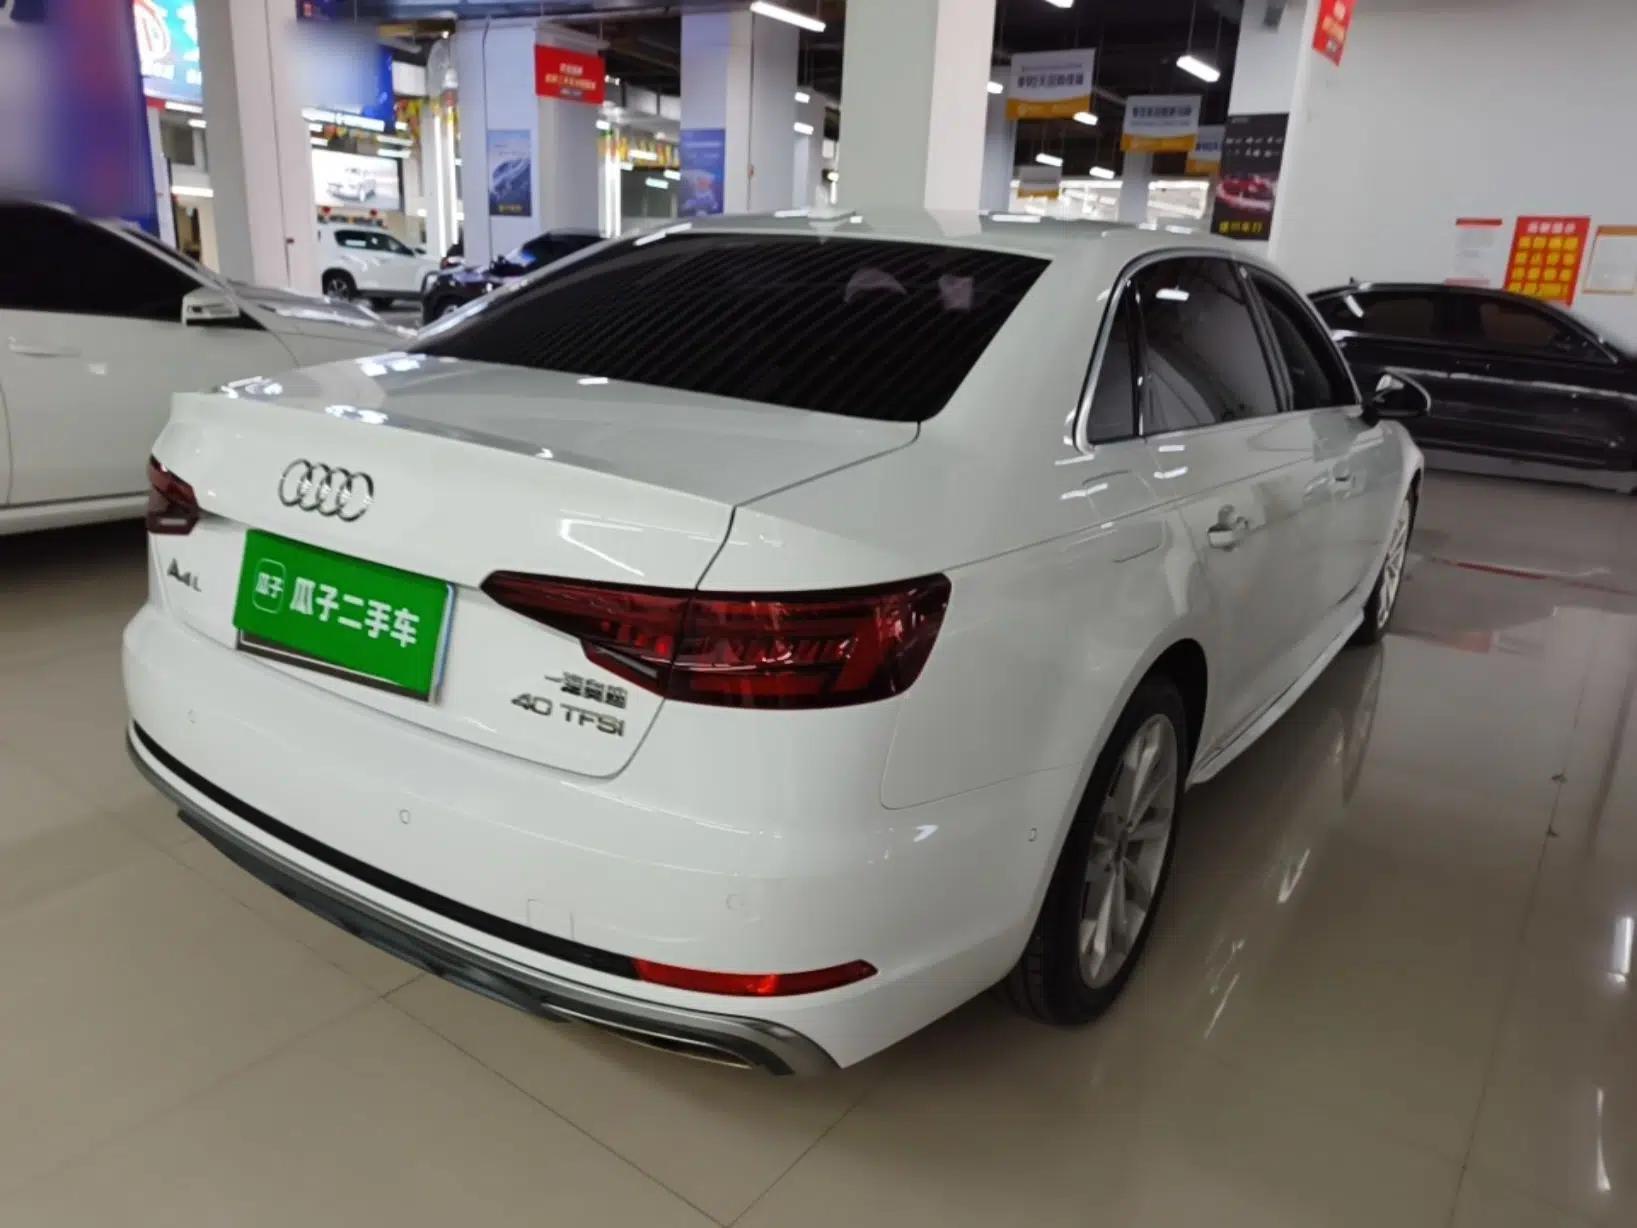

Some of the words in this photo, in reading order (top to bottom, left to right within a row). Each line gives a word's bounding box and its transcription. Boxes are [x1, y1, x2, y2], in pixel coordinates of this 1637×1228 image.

[167, 558, 203, 593] A4L
[257, 572, 285, 598] 瓜子
[289, 577, 420, 648] 瓜子二手车
[511, 692, 553, 717] 40
[560, 703, 626, 737] TFSI
